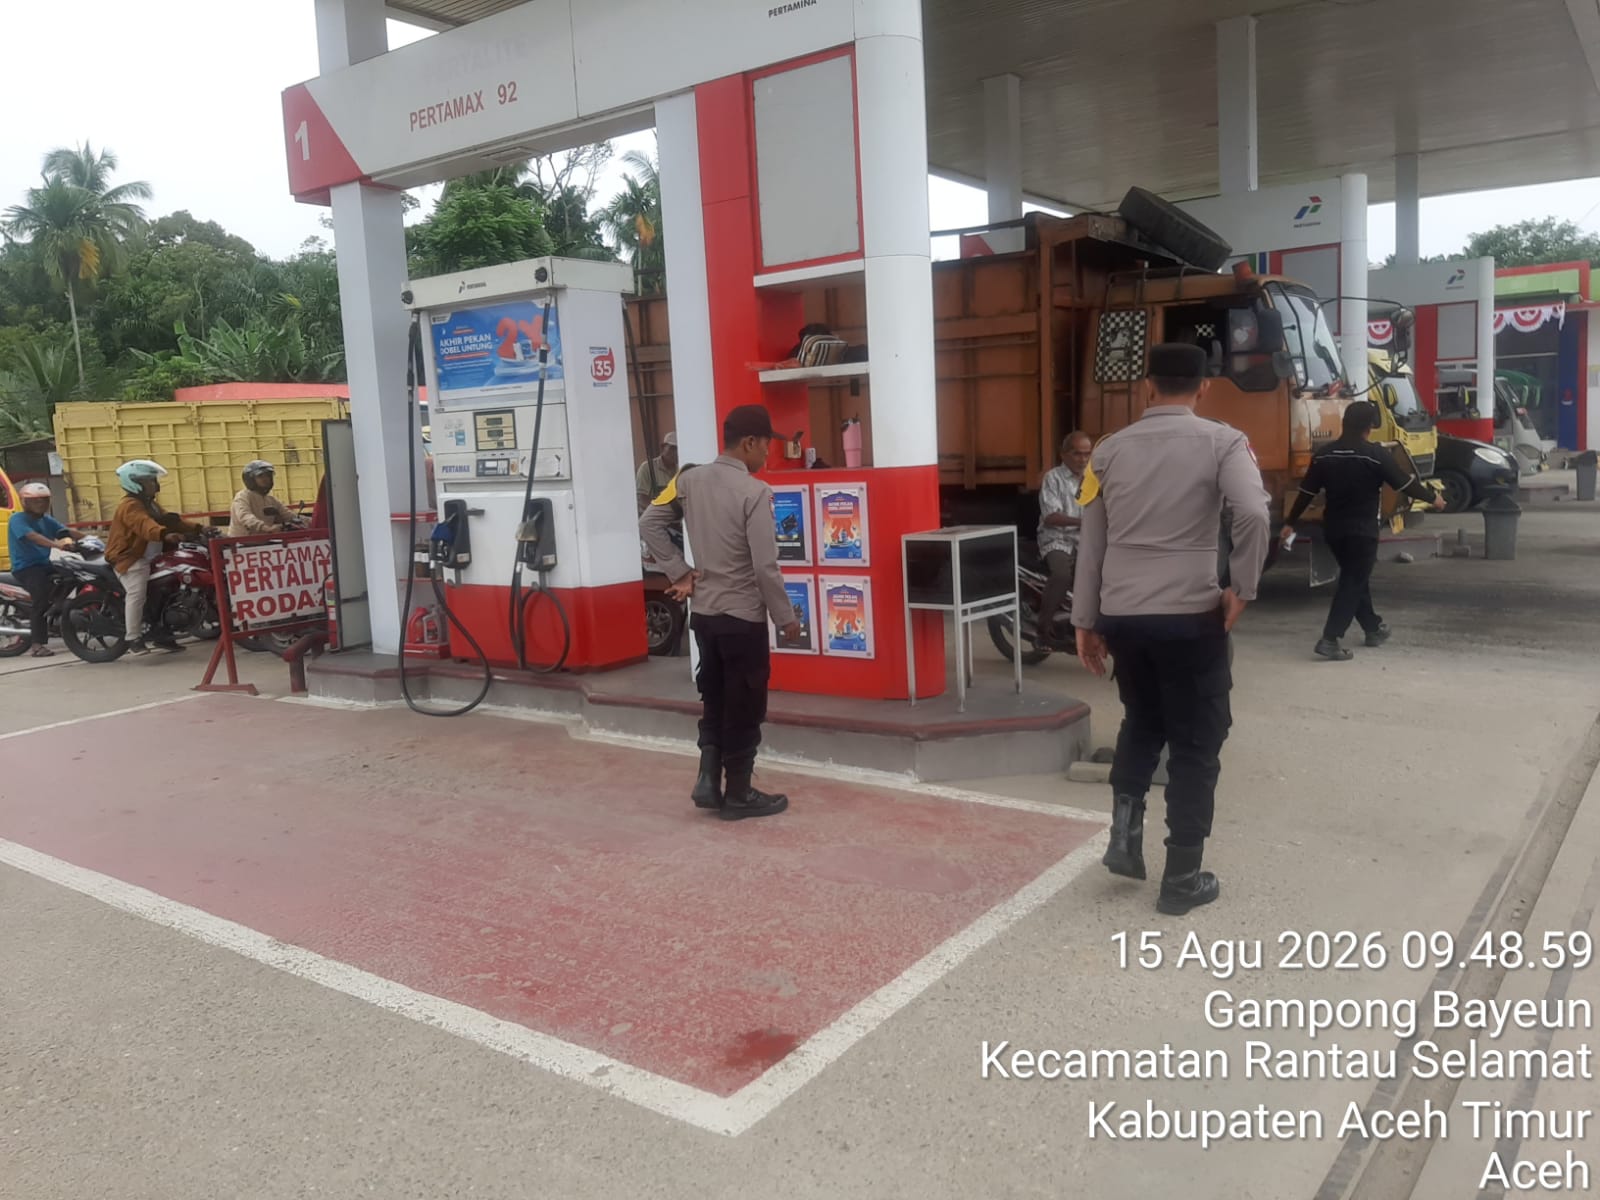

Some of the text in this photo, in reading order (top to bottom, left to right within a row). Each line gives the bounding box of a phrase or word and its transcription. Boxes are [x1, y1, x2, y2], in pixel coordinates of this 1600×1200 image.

[768, 0, 817, 19] PERTAMINA
[410, 81, 518, 132] PERTAMAX 92
[294, 120, 310, 160] 1
[439, 333, 491, 348] AKHIR PEKAN
